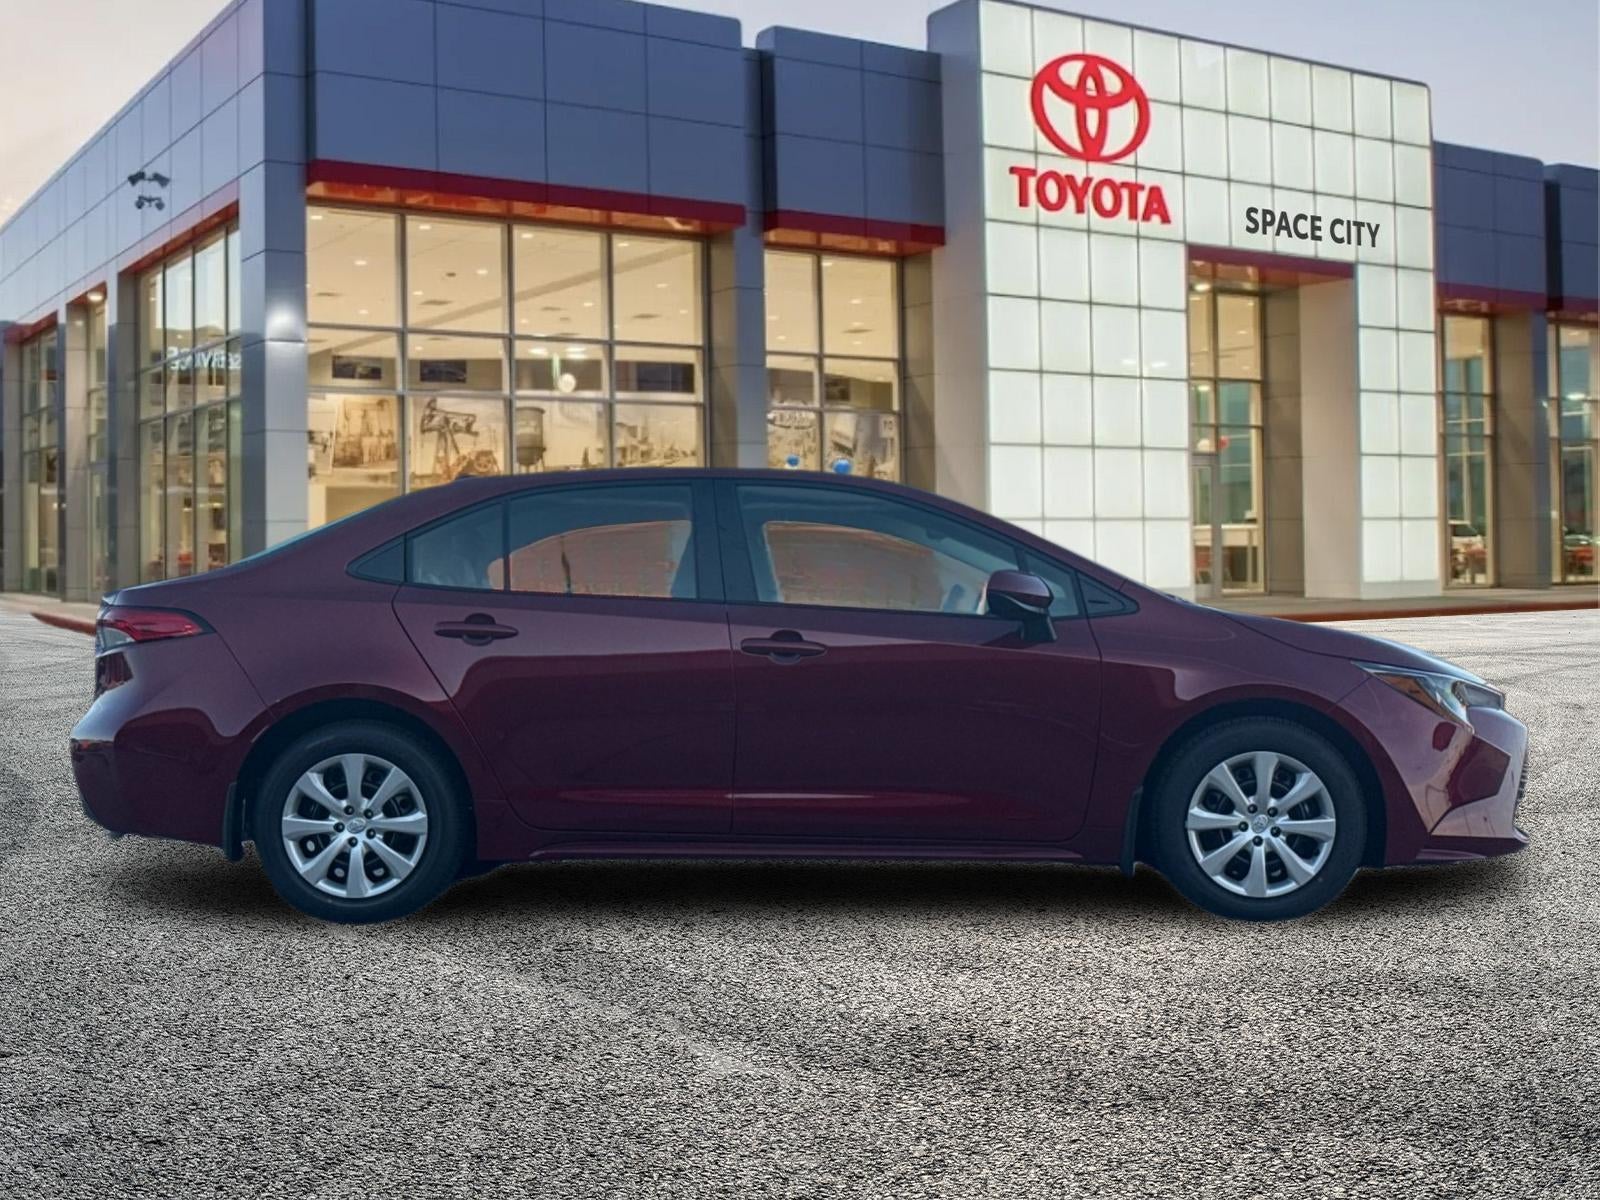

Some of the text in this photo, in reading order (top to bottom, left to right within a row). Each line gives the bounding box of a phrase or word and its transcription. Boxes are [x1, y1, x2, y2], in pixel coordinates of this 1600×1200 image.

[1009, 166, 1170, 224] TOYOTA
[1245, 206, 1381, 248] SPACE CITY
